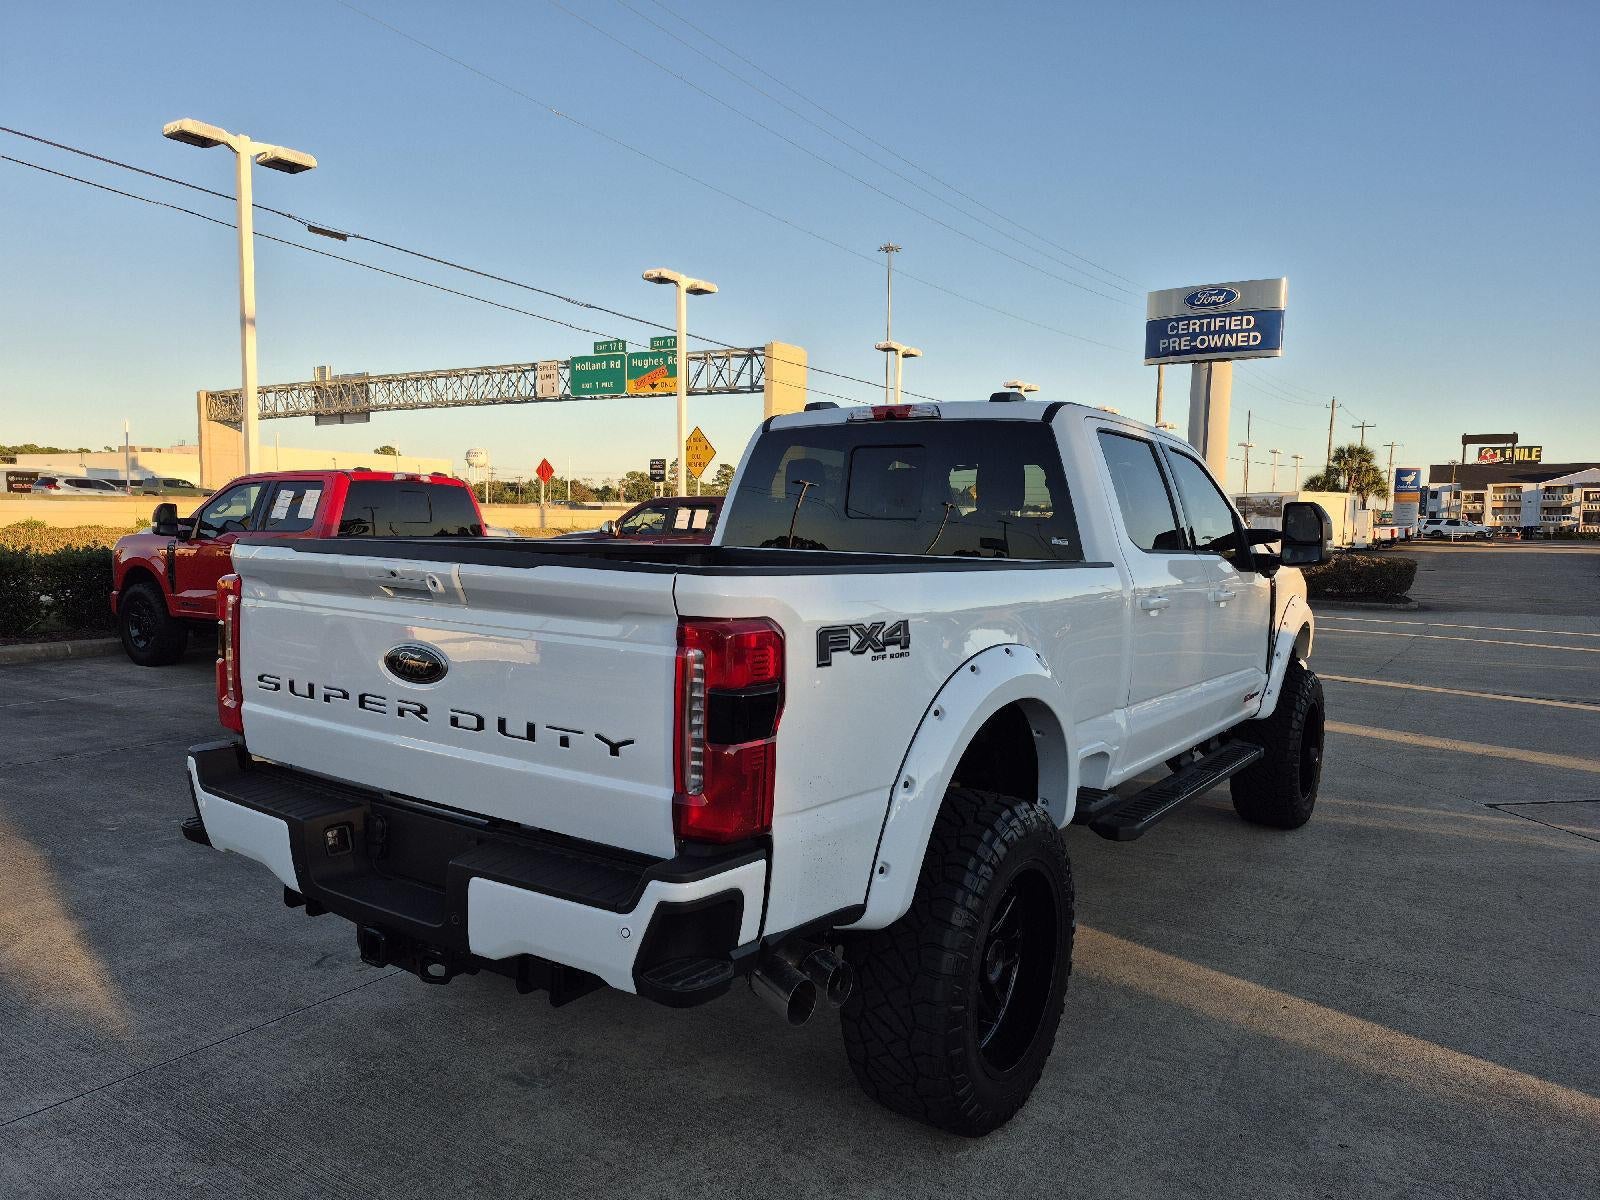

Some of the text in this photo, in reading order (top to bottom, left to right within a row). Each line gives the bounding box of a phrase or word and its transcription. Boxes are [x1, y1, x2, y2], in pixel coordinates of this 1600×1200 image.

[1194, 288, 1227, 305] Ford
[1167, 315, 1255, 335] CERTIFIED
[609, 343, 618, 351] 17
[667, 338, 675, 346] 17
[1160, 332, 1262, 352] PRE-OWNED
[538, 364, 557, 372] SPEED
[575, 360, 621, 371] Holland Rd
[632, 357, 664, 368] Hughes
[540, 373, 555, 381] LIMIT
[595, 381, 599, 389] 1
[660, 381, 677, 389] ONLY
[816, 619, 911, 667] FX4
[871, 651, 910, 662] OFF ROAD
[397, 651, 433, 674] Ford
[257, 673, 635, 757] SUPER DUTY
